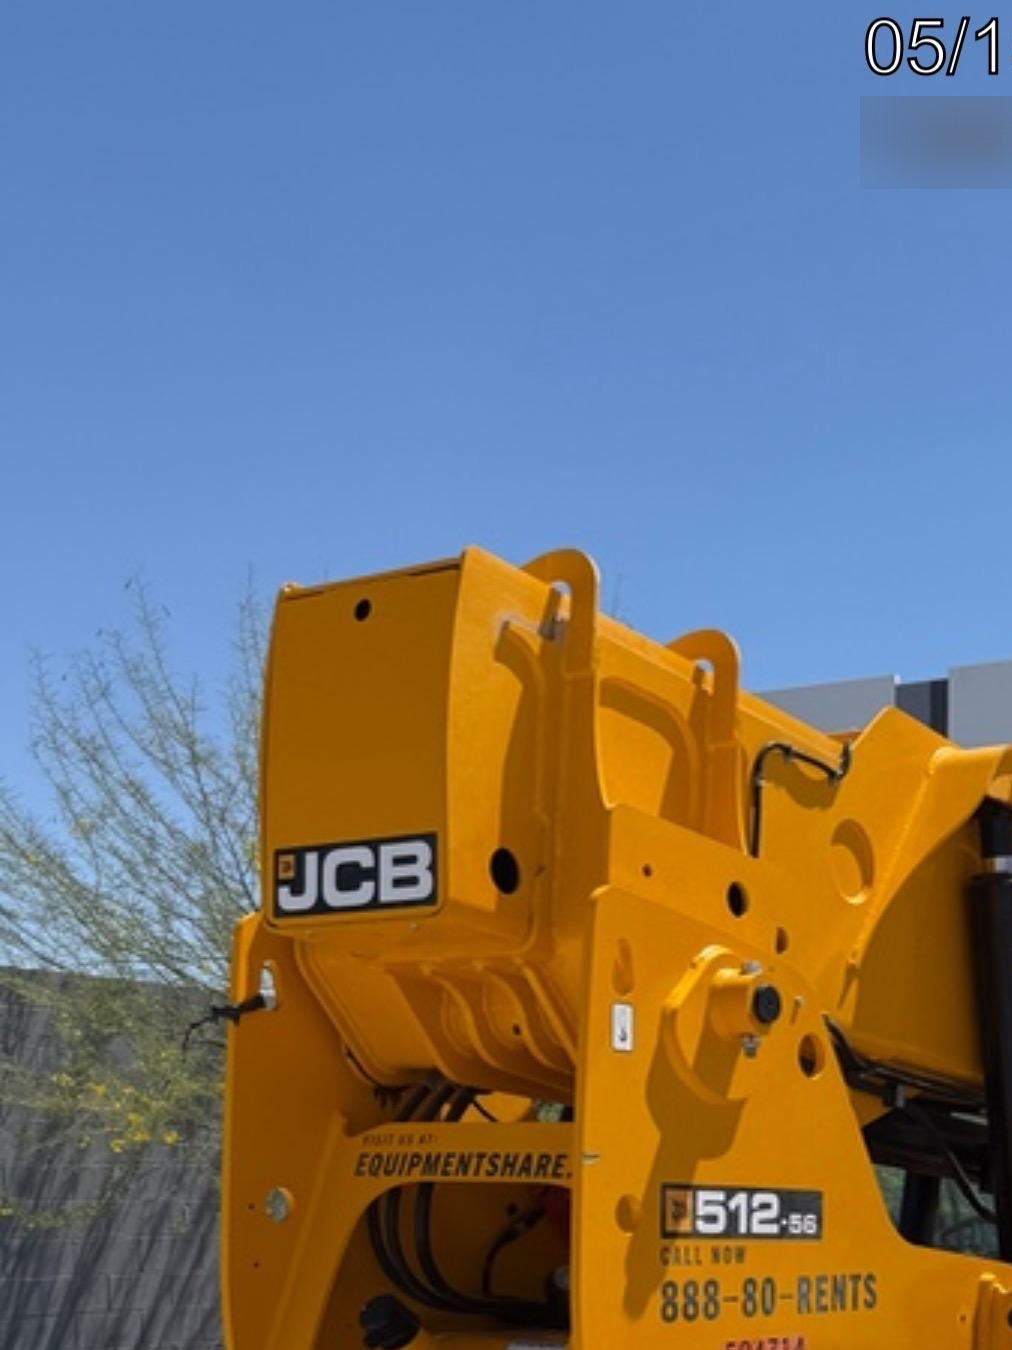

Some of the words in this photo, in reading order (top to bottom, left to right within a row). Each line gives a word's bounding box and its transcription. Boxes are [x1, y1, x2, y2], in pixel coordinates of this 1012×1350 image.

[277, 838, 434, 912] JCB
[660, 1246, 703, 1266] CALL
[711, 1244, 746, 1264] NOW
[661, 1272, 878, 1323] 888-80-RENTS
